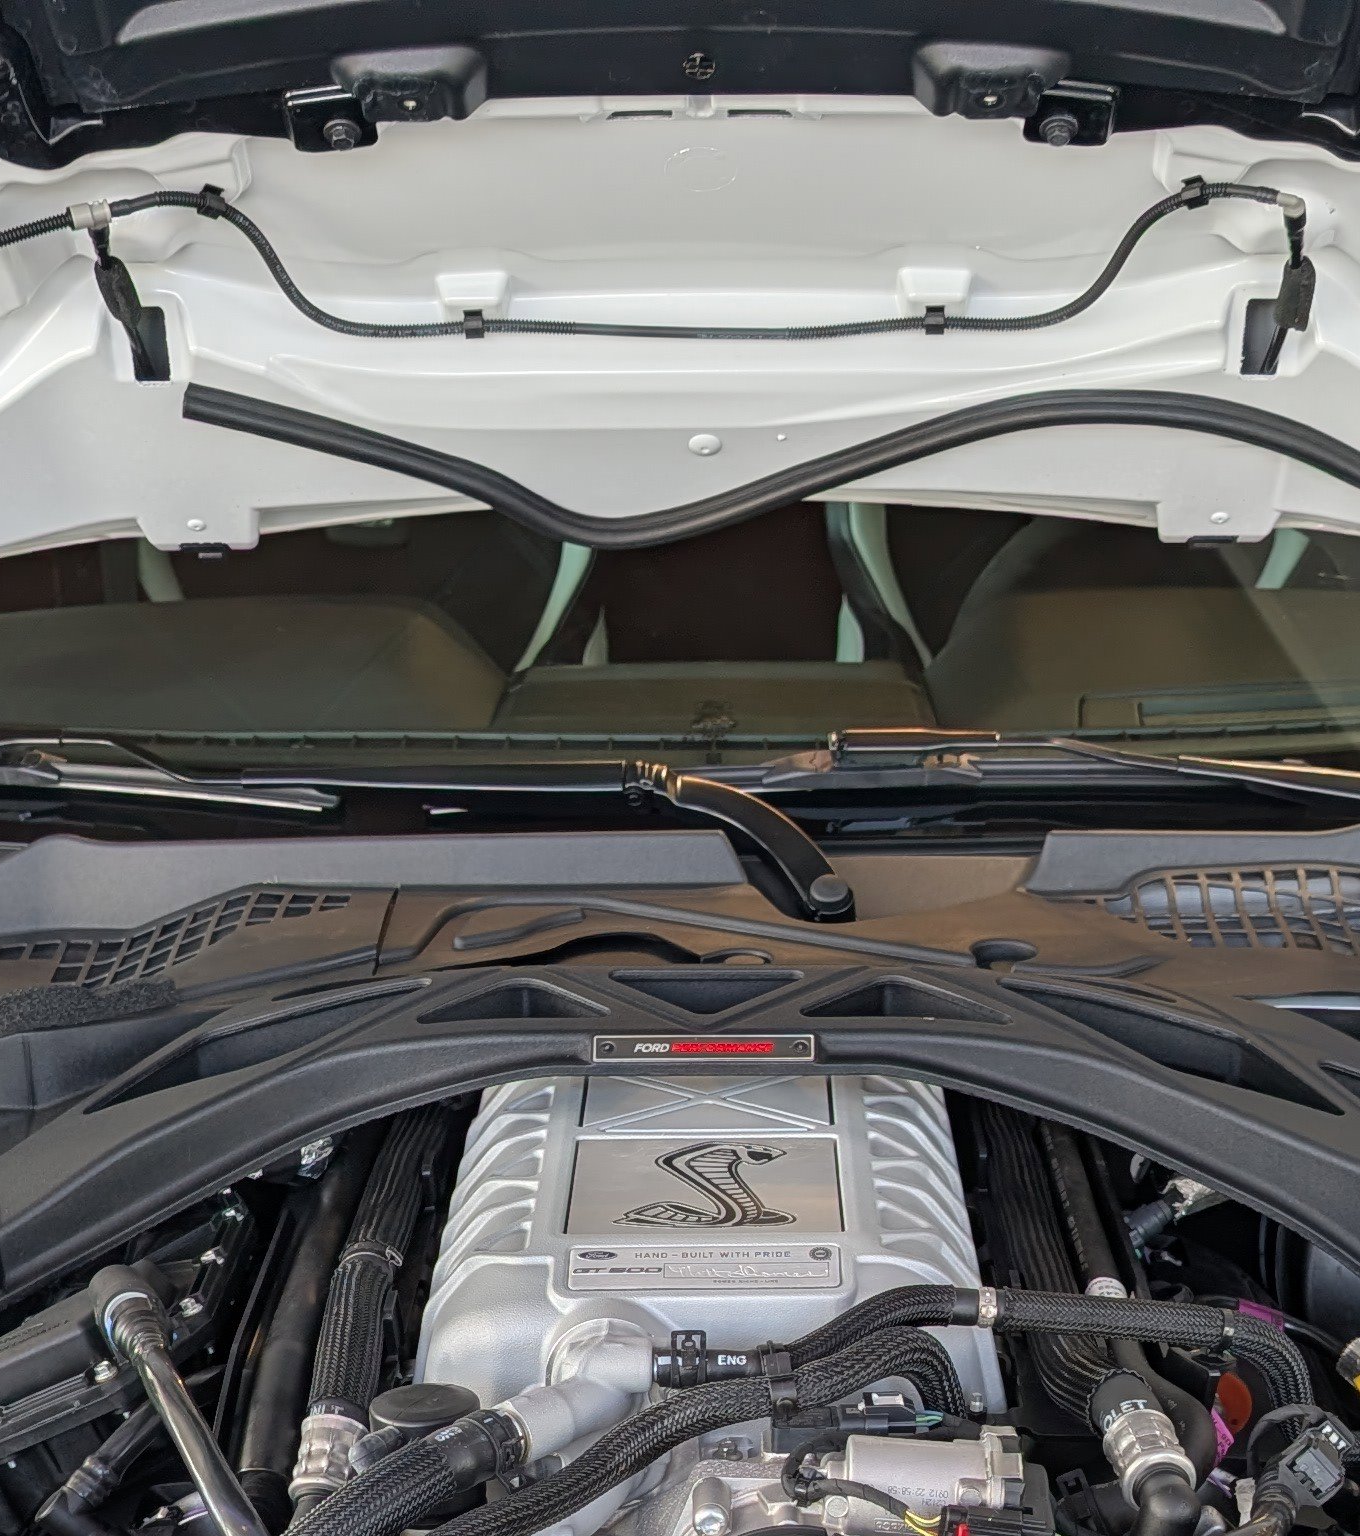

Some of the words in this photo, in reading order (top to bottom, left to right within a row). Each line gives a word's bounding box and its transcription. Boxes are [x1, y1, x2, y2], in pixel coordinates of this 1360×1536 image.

[634, 1043, 670, 1053] FORD
[671, 1042, 775, 1053] PERFORMANCE
[681, 1251, 714, 1259] BUILT
[717, 1354, 747, 1366] ENG
